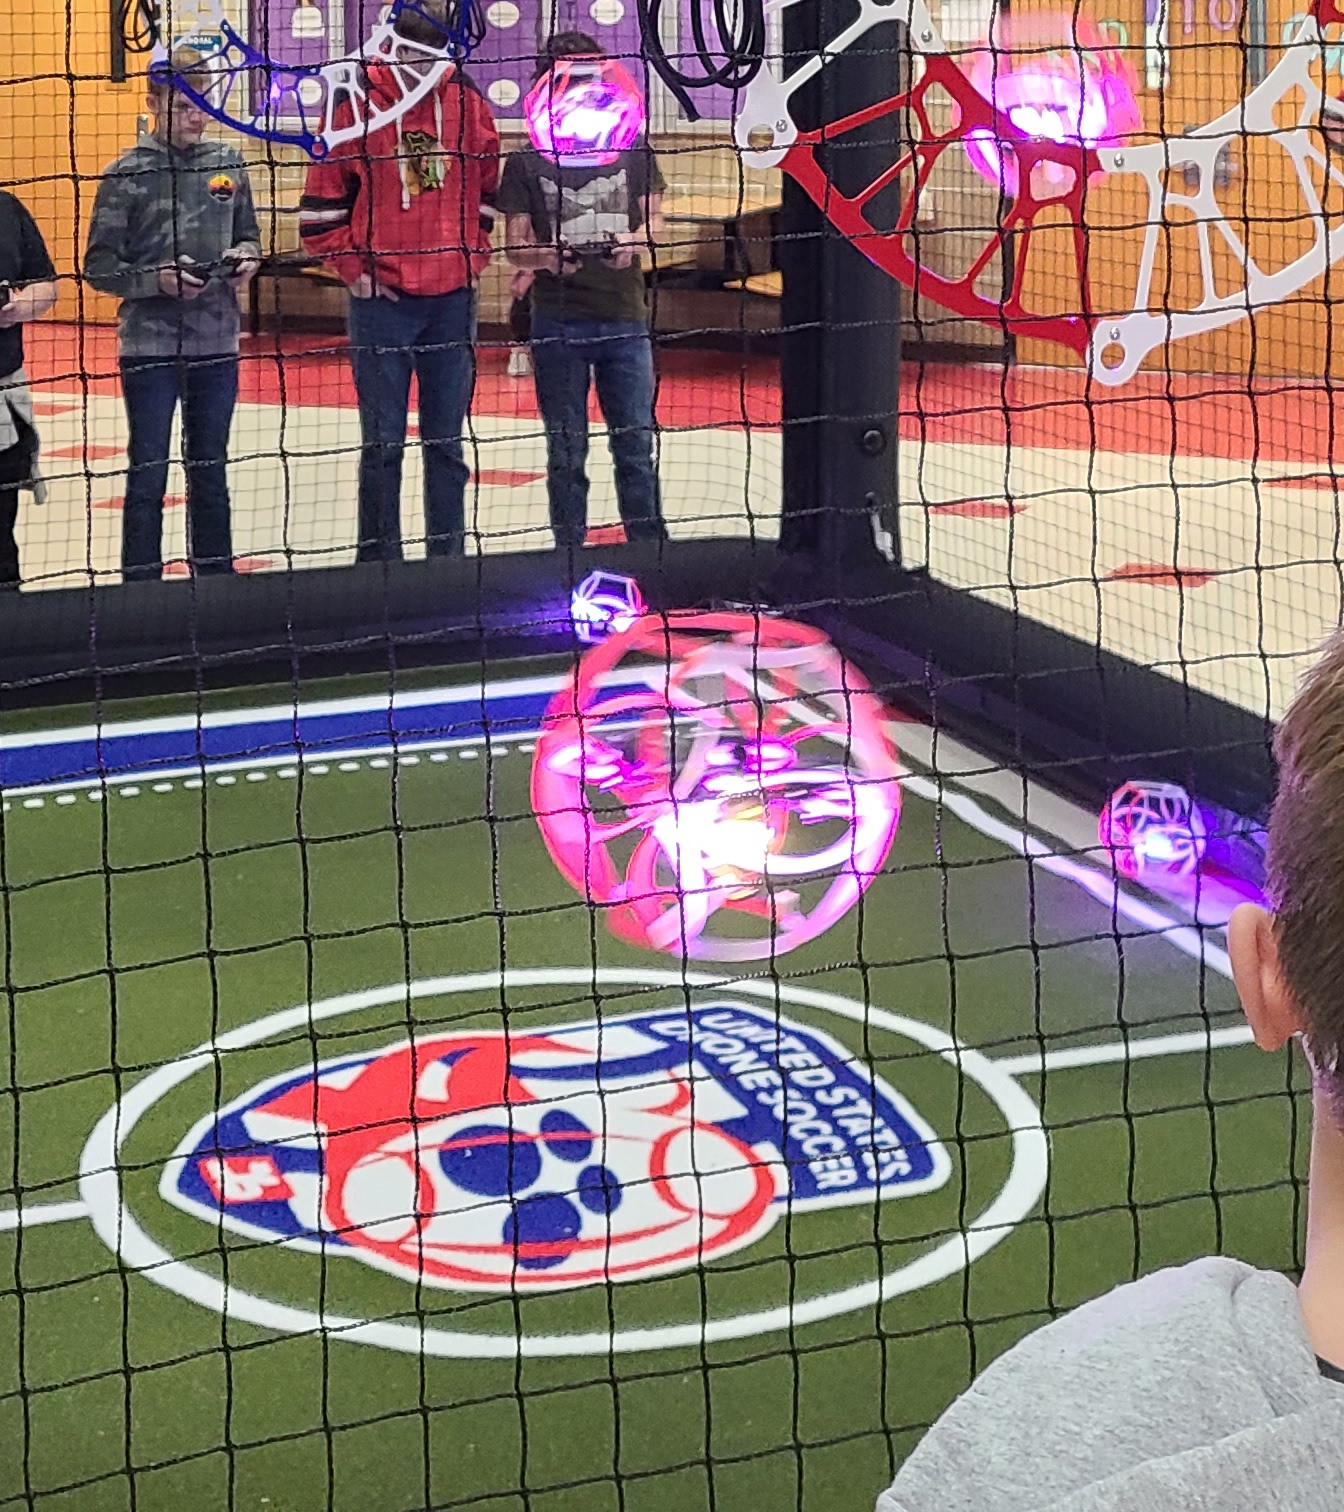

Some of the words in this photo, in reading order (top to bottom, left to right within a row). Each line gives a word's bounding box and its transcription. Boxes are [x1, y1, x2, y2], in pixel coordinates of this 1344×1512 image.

[649, 1019, 784, 1091] DRONE
[756, 1088, 859, 1191] SOCCER
[699, 1011, 837, 1088] UNITED
[814, 1085, 913, 1182] STATES
